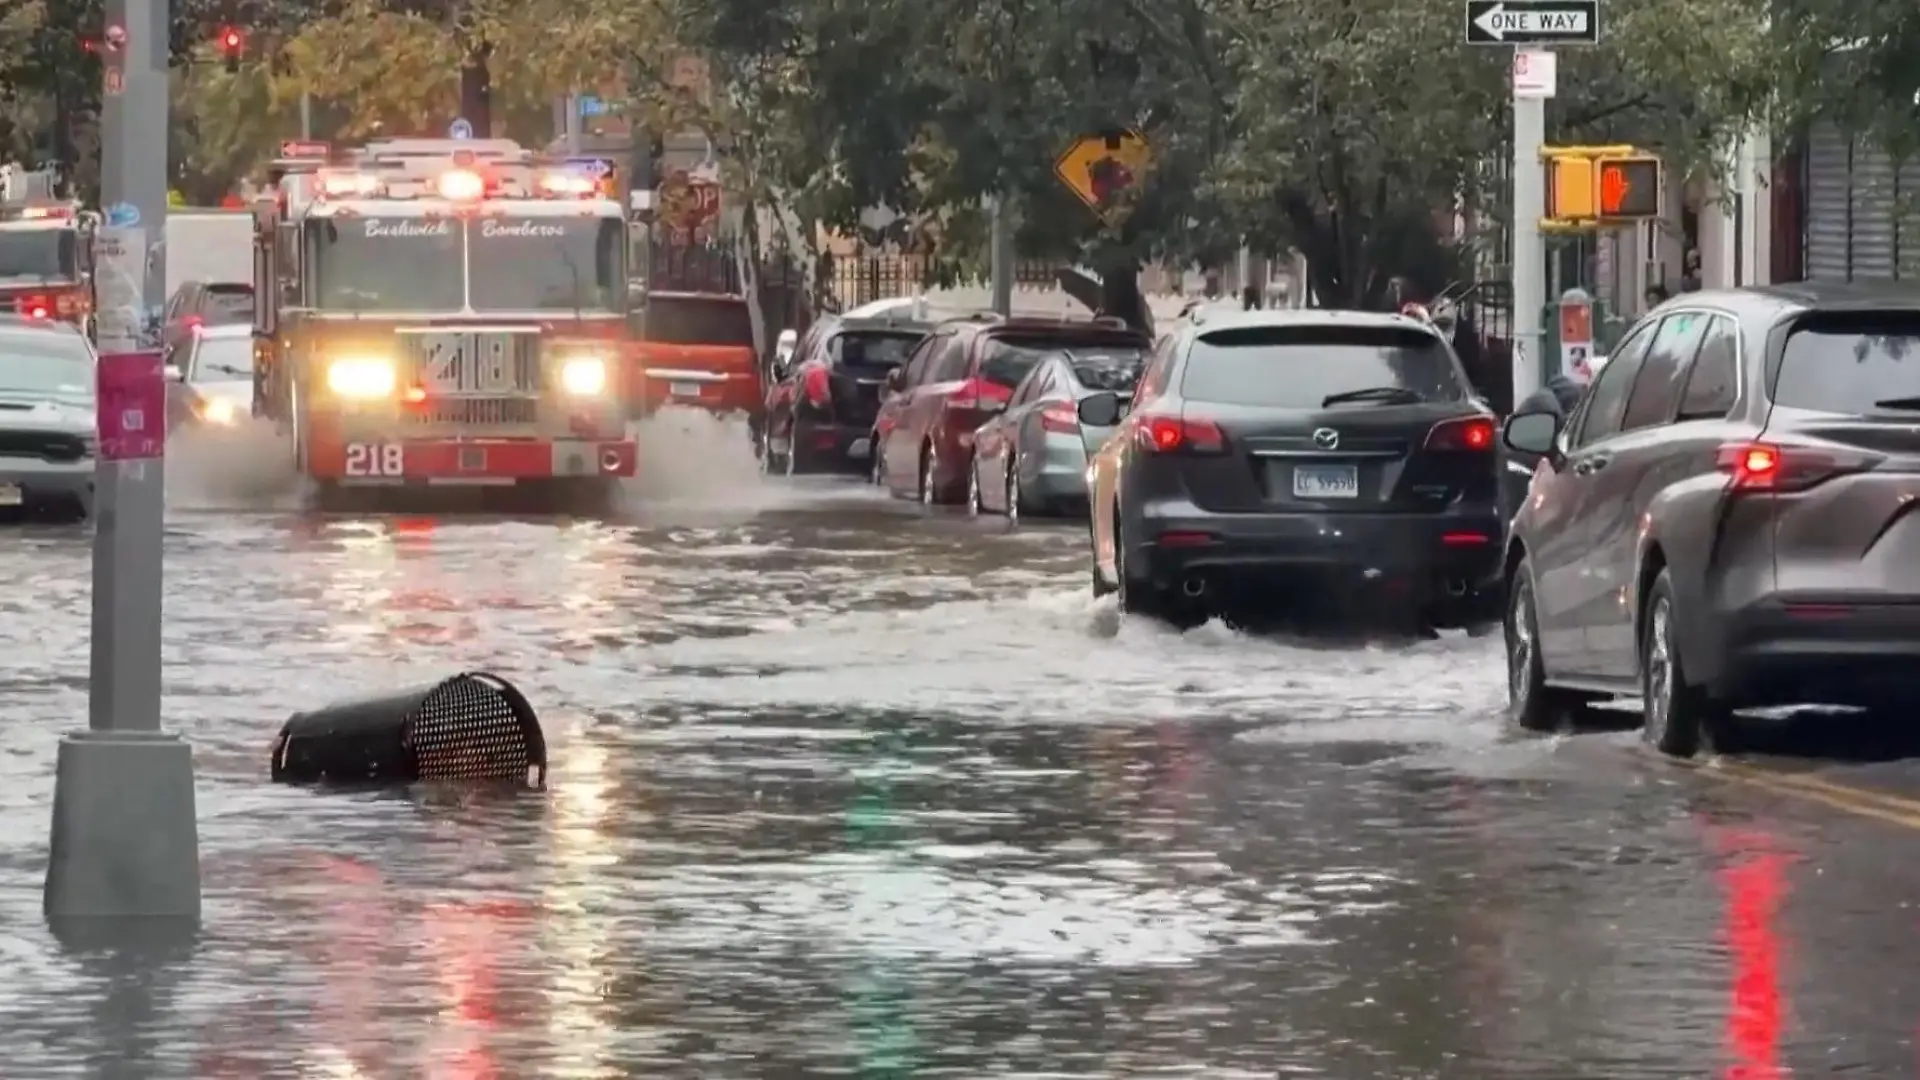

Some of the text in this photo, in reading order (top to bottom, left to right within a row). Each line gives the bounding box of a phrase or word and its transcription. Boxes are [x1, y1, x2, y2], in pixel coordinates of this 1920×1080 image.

[1491, 13, 1578, 29] ONE WAY
[364, 218, 564, 238] Bushwick Bomberos
[346, 444, 404, 476] 218
